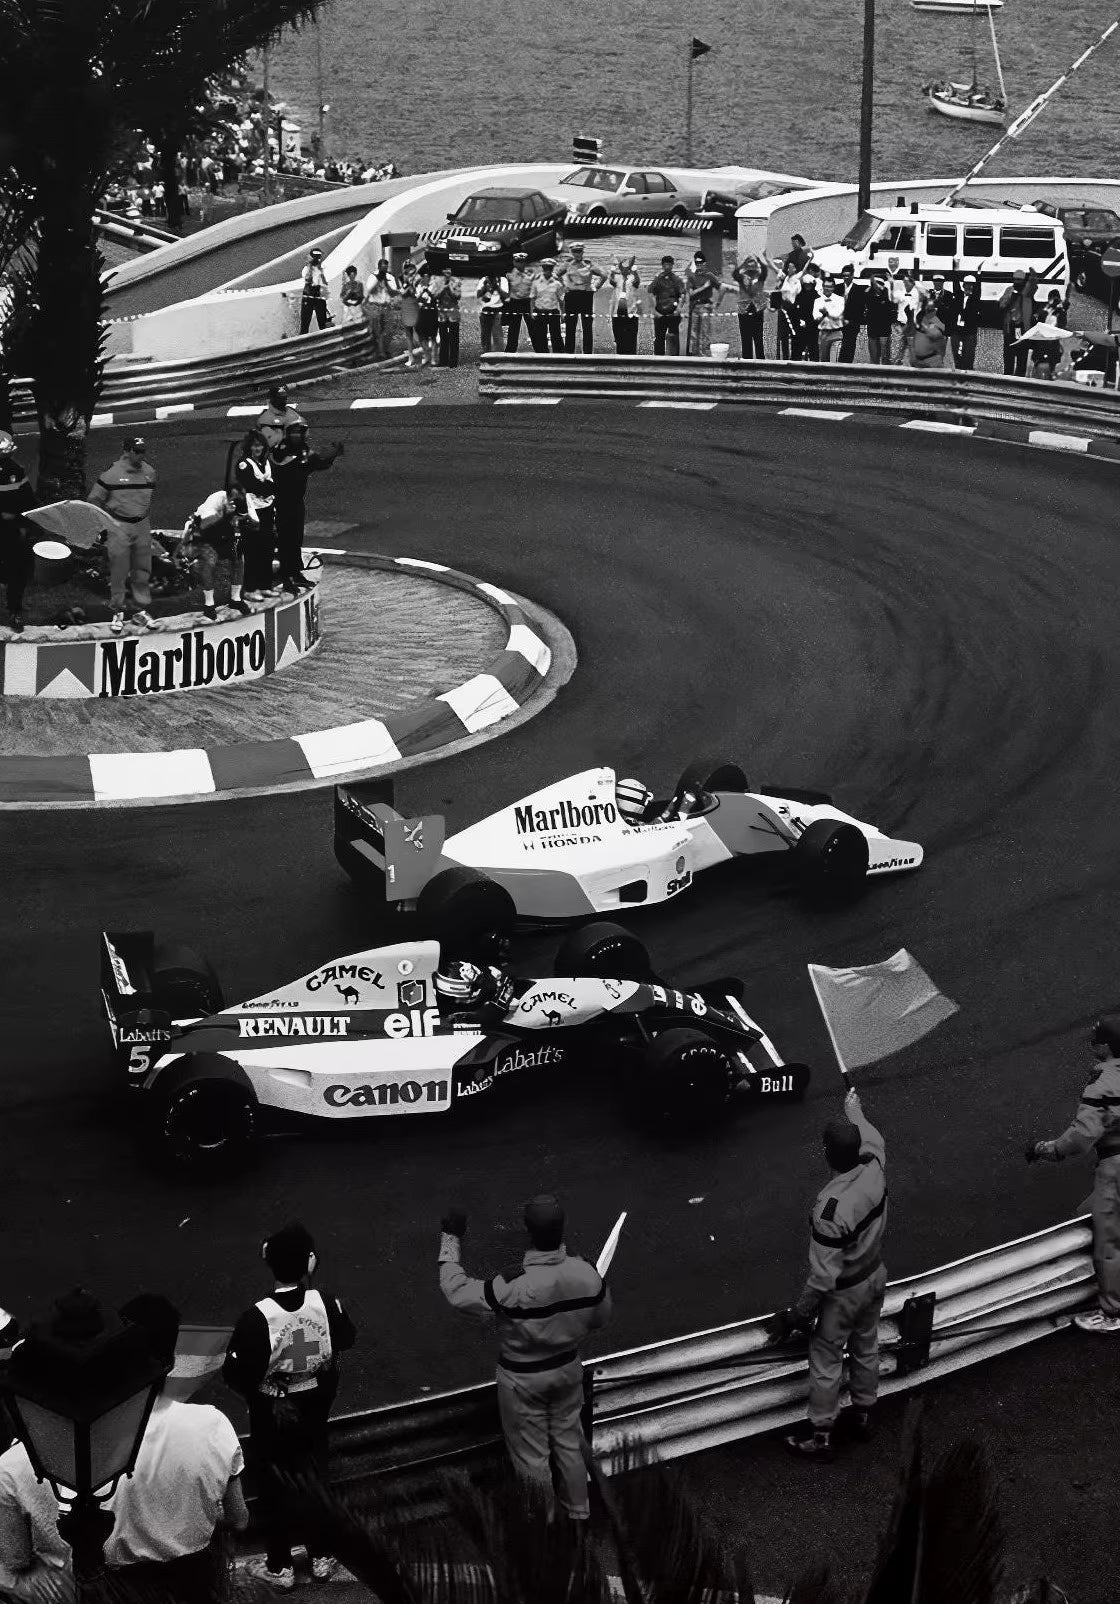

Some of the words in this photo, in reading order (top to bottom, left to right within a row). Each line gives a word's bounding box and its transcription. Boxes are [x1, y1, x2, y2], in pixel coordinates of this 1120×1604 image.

[100, 629, 266, 698] Marlboro
[514, 800, 617, 835] Marlboro
[305, 964, 385, 992] CAMEL
[520, 991, 577, 1013] CAMEL
[238, 1016, 350, 1038] RENAULT
[383, 1008, 441, 1040] elf
[128, 1044, 151, 1074] 5
[494, 1045, 564, 1077] Labatt's
[323, 1080, 448, 1108] Canon
[761, 1075, 794, 1093] Bull
